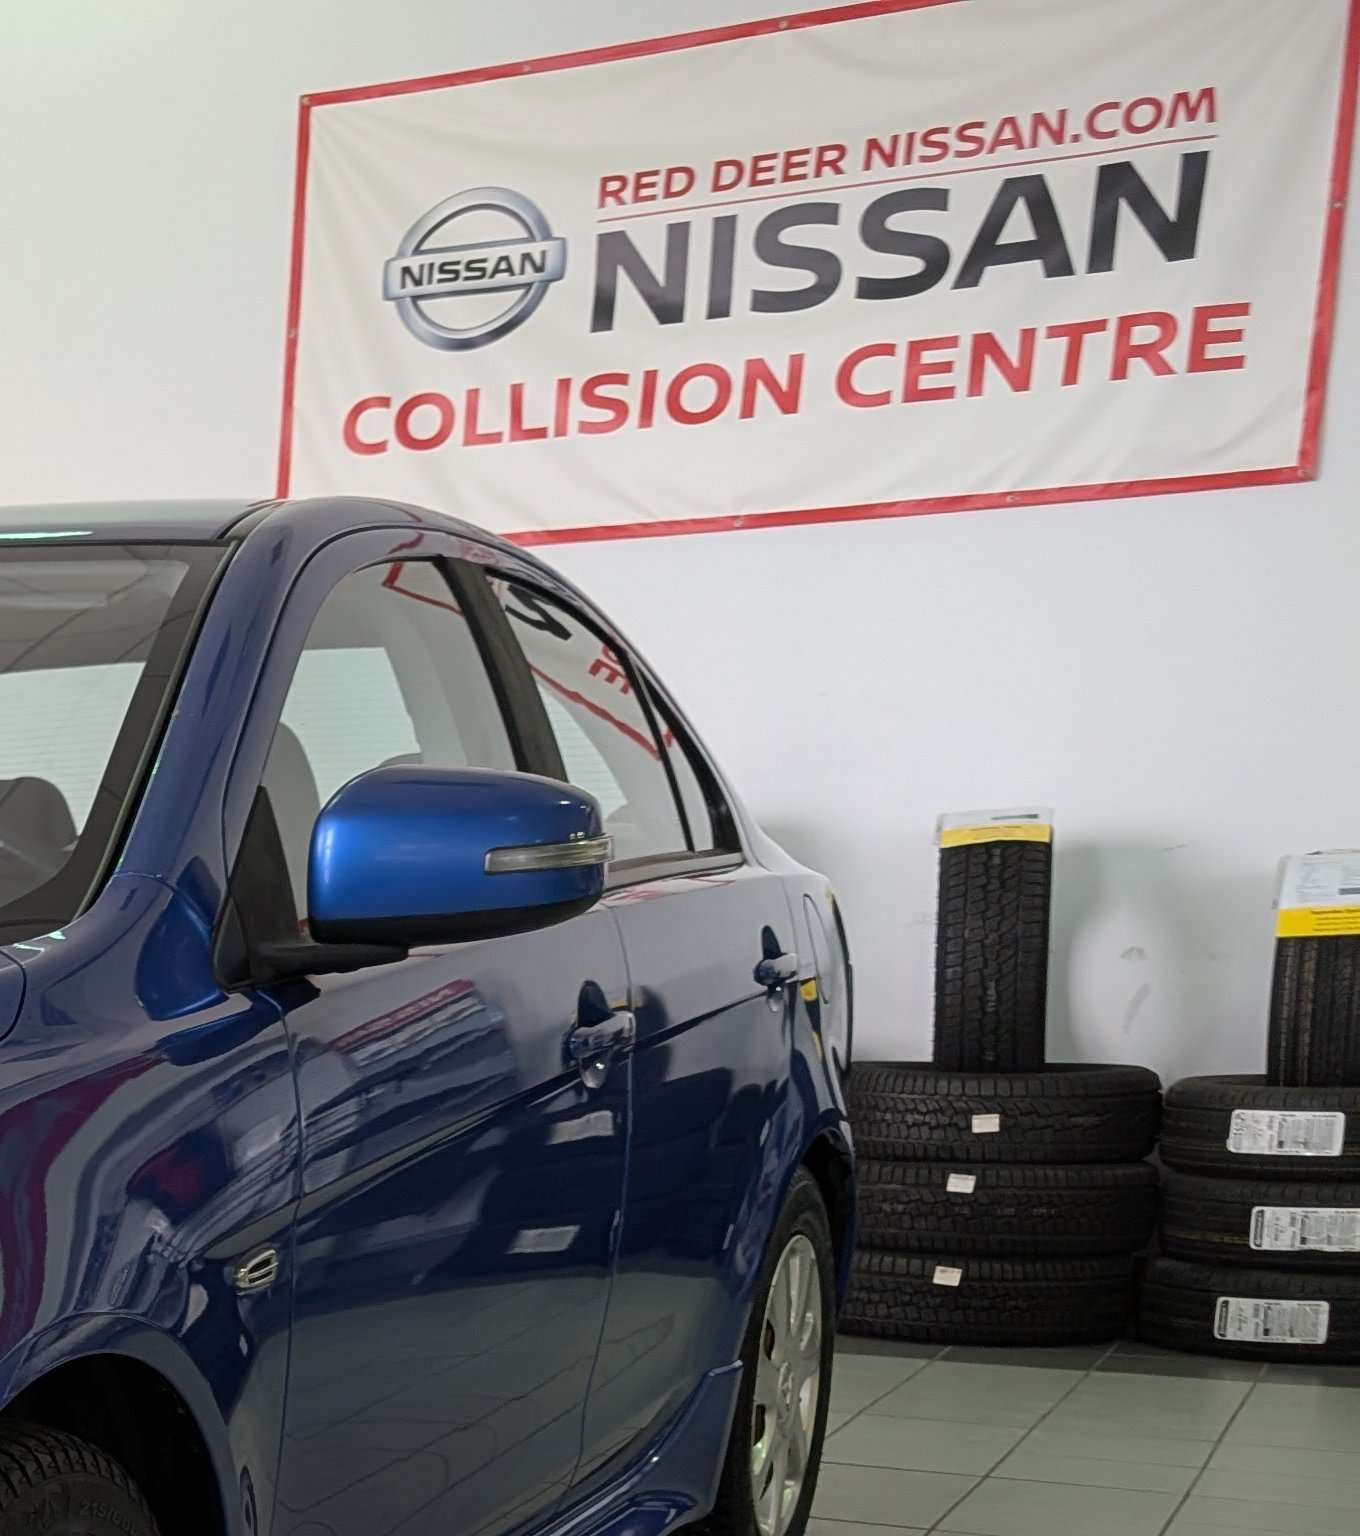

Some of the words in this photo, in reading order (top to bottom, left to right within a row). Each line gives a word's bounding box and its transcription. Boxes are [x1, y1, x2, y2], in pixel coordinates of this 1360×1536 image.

[597, 164, 697, 209] RED
[711, 142, 850, 194] DEER
[862, 86, 1218, 171] NISSAN.COM
[400, 250, 547, 290] NISSAN
[590, 149, 1212, 334] NISSAN
[341, 352, 807, 458] COLLISION
[834, 302, 1252, 410] CENTRE
